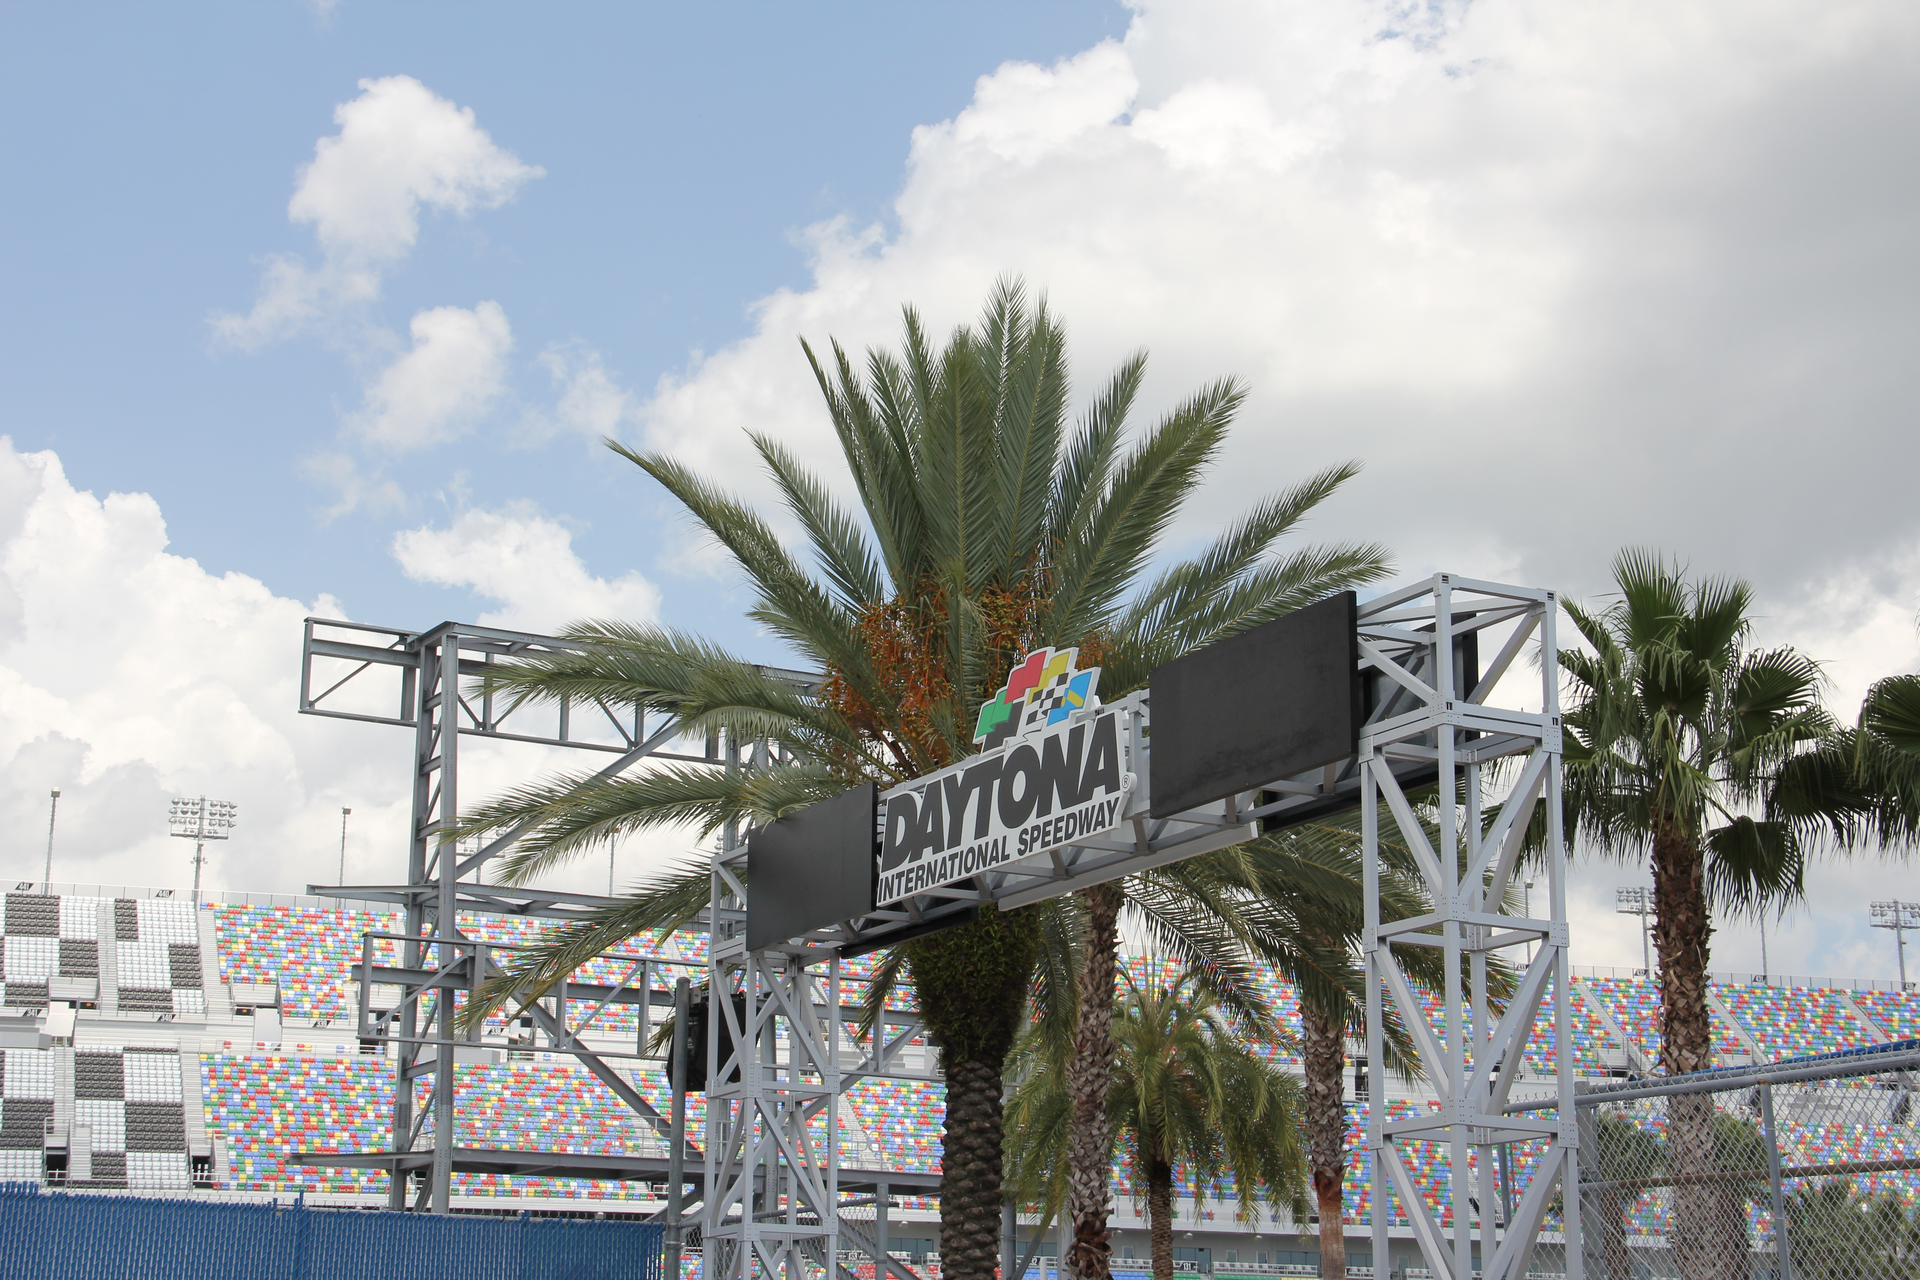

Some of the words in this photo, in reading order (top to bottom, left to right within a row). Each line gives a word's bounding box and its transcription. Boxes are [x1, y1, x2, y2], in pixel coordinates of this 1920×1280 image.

[878, 835, 1010, 904] INTERNATIONAL
[1017, 797, 1120, 857] SPEEDWAY
[881, 712, 1120, 873] DAYTONA
